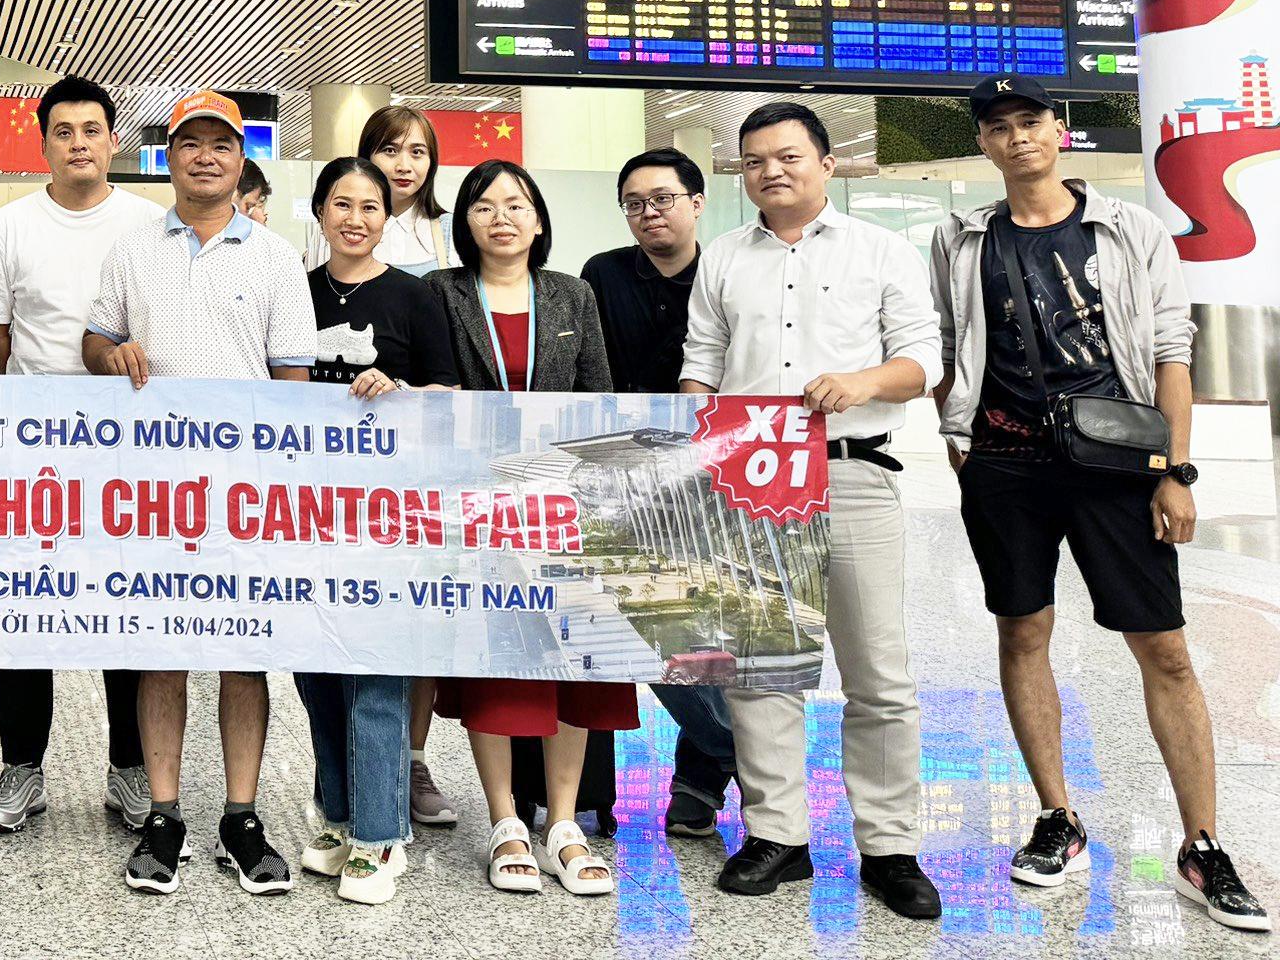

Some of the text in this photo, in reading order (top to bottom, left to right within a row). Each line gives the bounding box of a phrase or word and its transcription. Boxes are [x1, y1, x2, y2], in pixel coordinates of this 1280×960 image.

[1078, 14, 1126, 27] Arrivals
[548, 49, 574, 57] Arrivals
[996, 79, 1012, 92] K
[1071, 141, 1097, 149] Transfer
[312, 369, 356, 380] UTUR
[17, 411, 123, 448] CHÀO
[133, 412, 241, 451] MỪNG
[252, 422, 313, 453] ĐẠI
[326, 411, 398, 456] BIỂU
[744, 404, 813, 443] XE
[744, 447, 810, 488] 01
[101, 476, 211, 554] CHỢ
[226, 483, 446, 549] CANTON
[461, 493, 582, 553] FAIR
[104, 572, 238, 600] CANTON
[248, 577, 315, 603] FAIR
[325, 578, 381, 606] 135
[411, 575, 471, 615] VIỆT
[482, 585, 555, 611] NAM
[37, 609, 110, 634] HÀNH
[118, 615, 140, 634] 15
[162, 616, 273, 638] 18/04/2024
